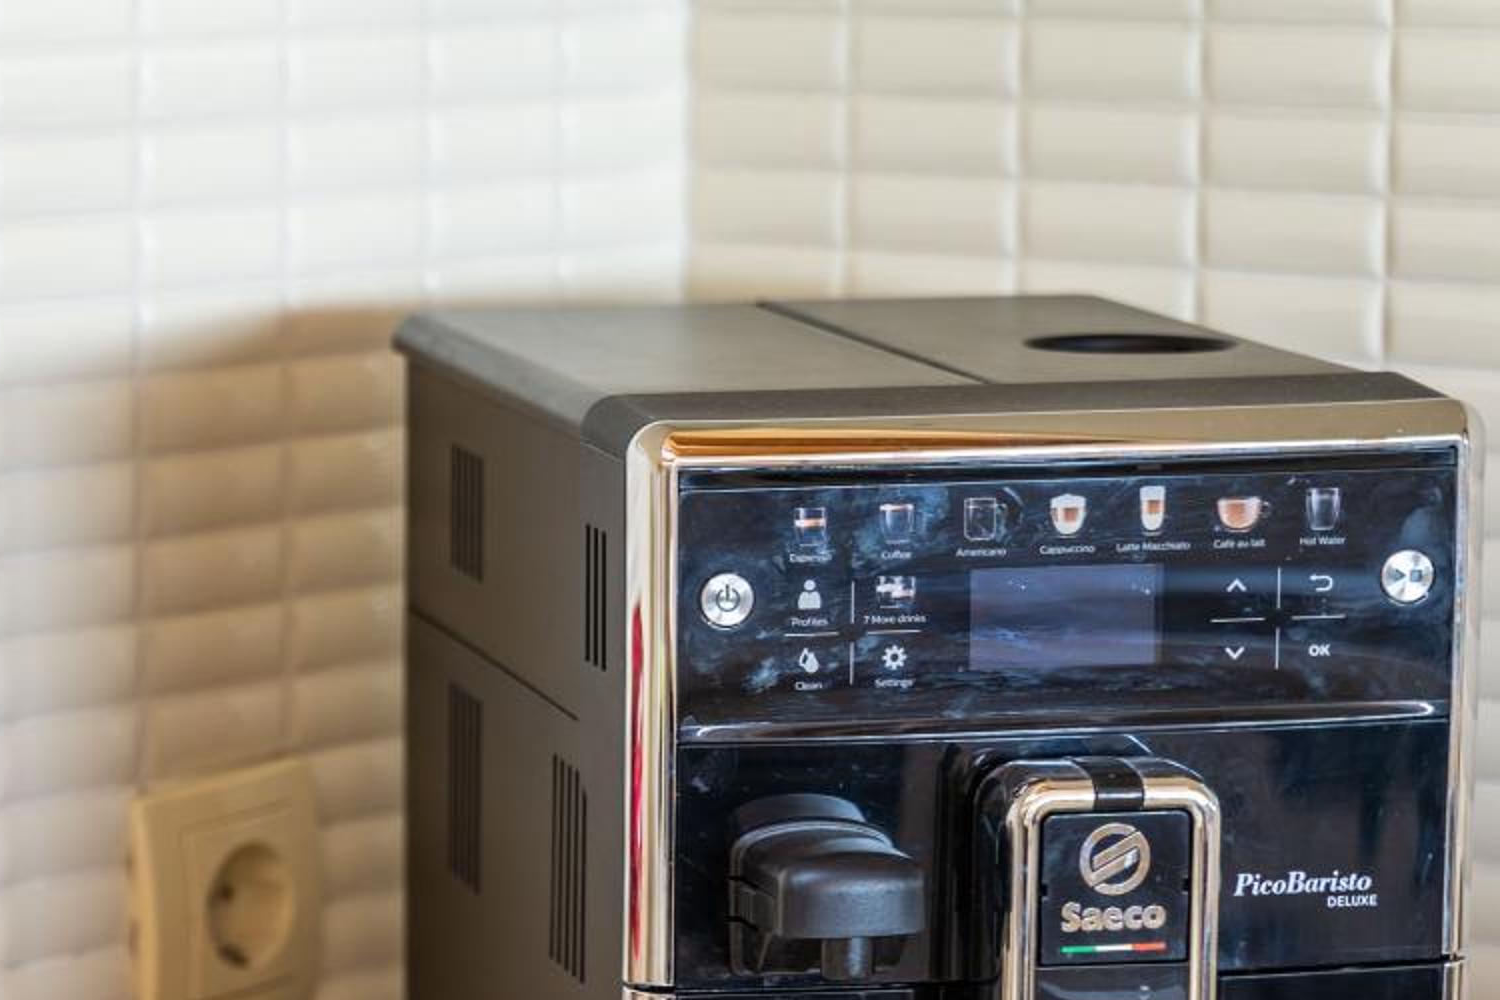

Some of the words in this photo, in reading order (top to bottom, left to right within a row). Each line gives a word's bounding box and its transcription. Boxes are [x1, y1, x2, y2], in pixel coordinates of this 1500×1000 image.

[1308, 644, 1331, 657] OK
[1233, 870, 1374, 897] PicoBaristo
[1327, 894, 1378, 908] DELUXE
[1061, 901, 1167, 933] Saeco
